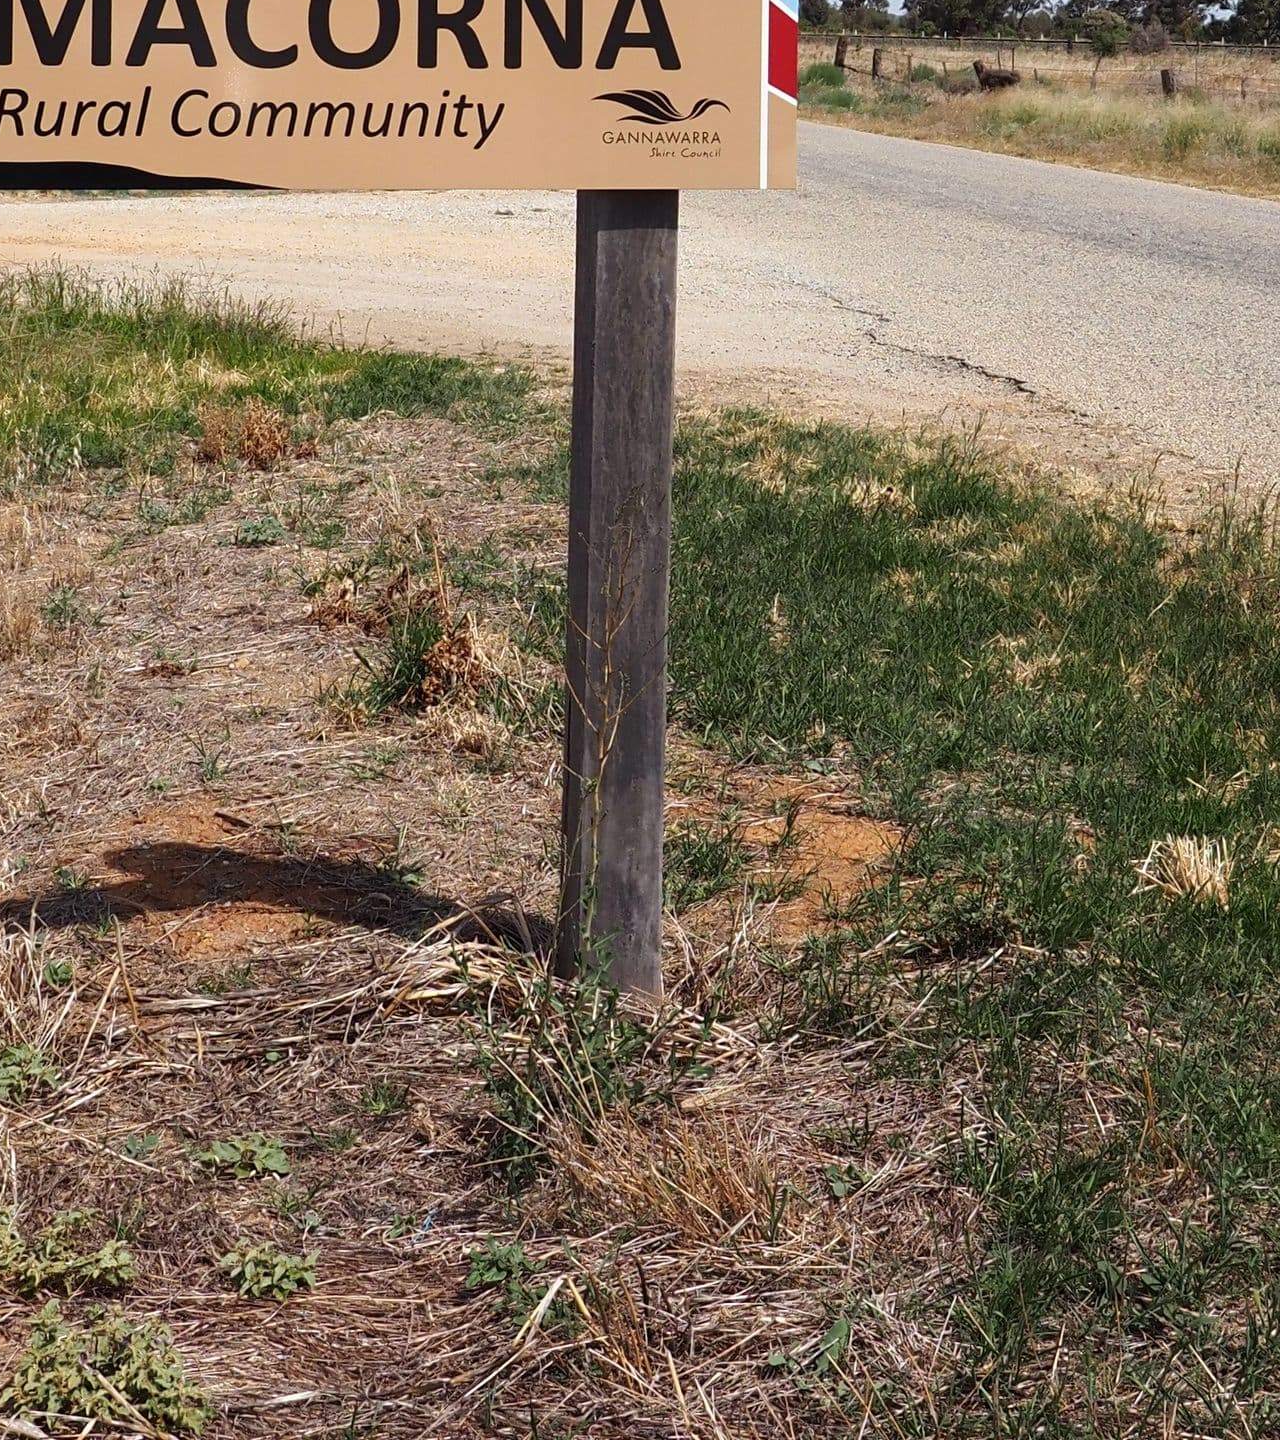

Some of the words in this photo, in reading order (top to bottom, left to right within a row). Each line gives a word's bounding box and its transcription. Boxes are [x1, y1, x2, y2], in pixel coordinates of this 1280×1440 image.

[171, 89, 504, 149] Community
[602, 131, 721, 144] GANNAWARRA
[649, 147, 676, 158] Shire
[680, 147, 721, 158] Council
